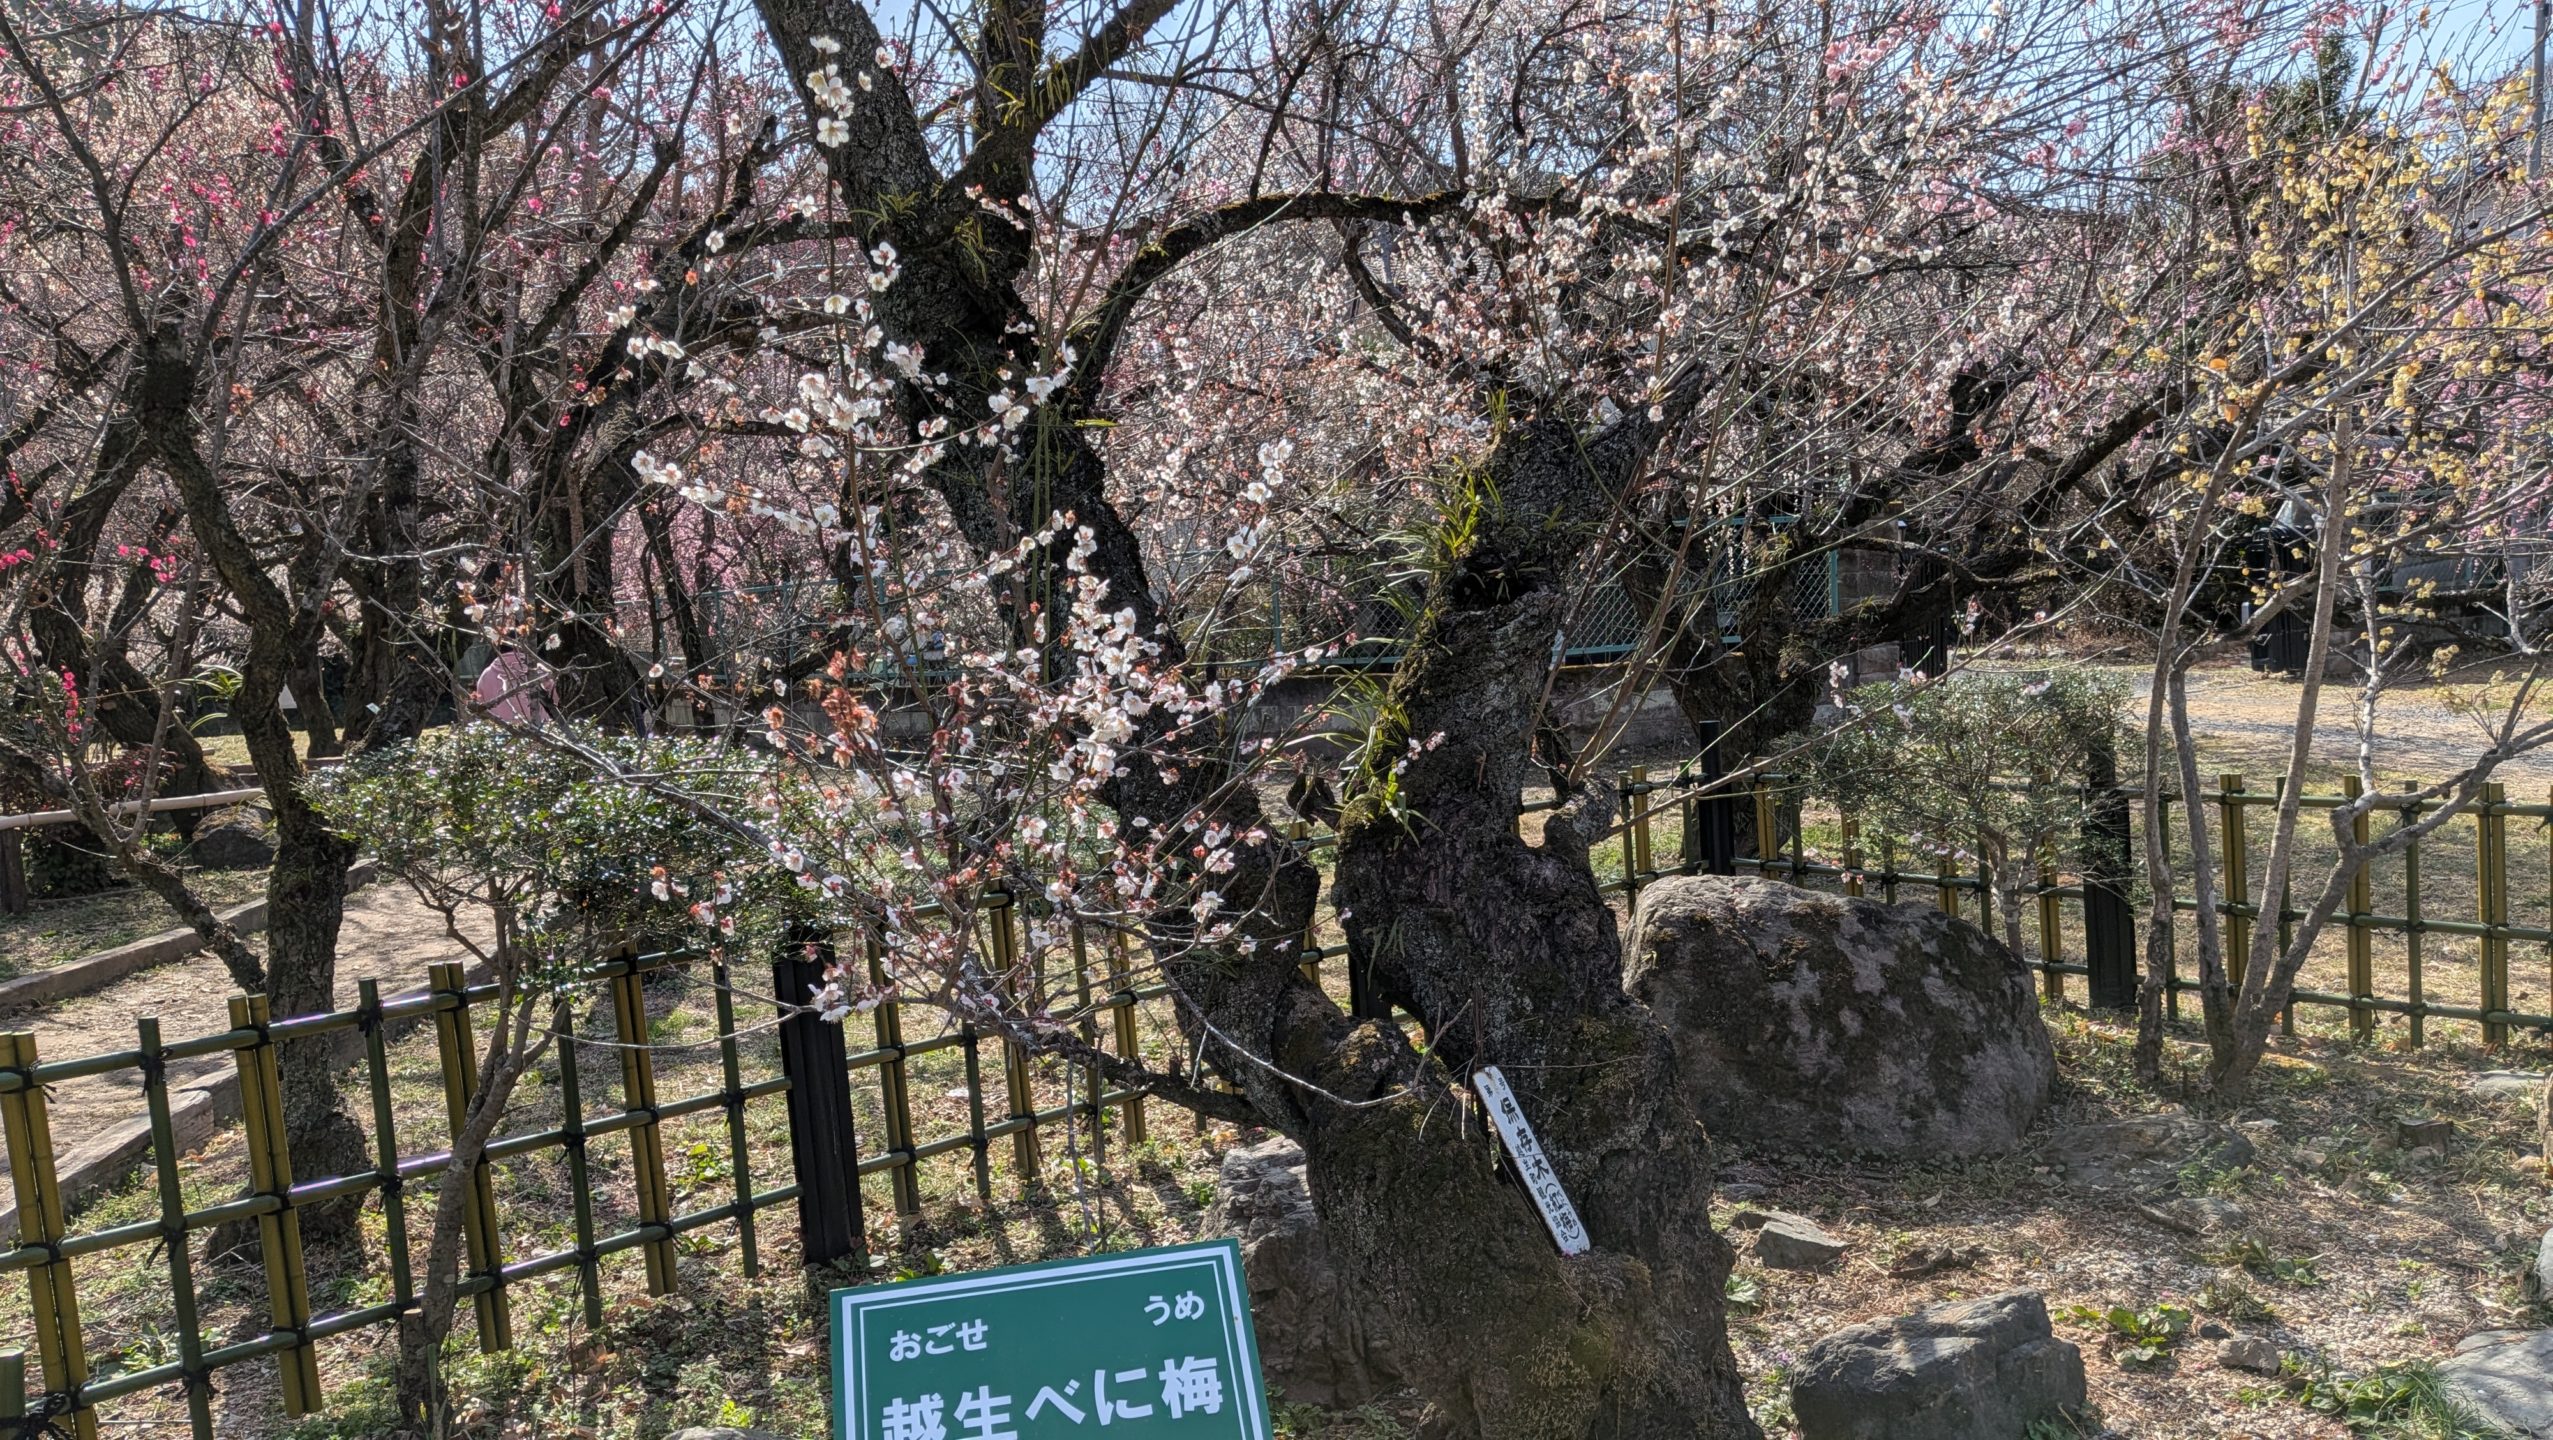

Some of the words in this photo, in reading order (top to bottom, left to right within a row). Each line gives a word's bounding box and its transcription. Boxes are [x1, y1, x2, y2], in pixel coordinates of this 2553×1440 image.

[1143, 1290, 1205, 1326] うめ
[889, 1318, 989, 1361] おごせ
[881, 1356, 1224, 1440] 越生べに梅
